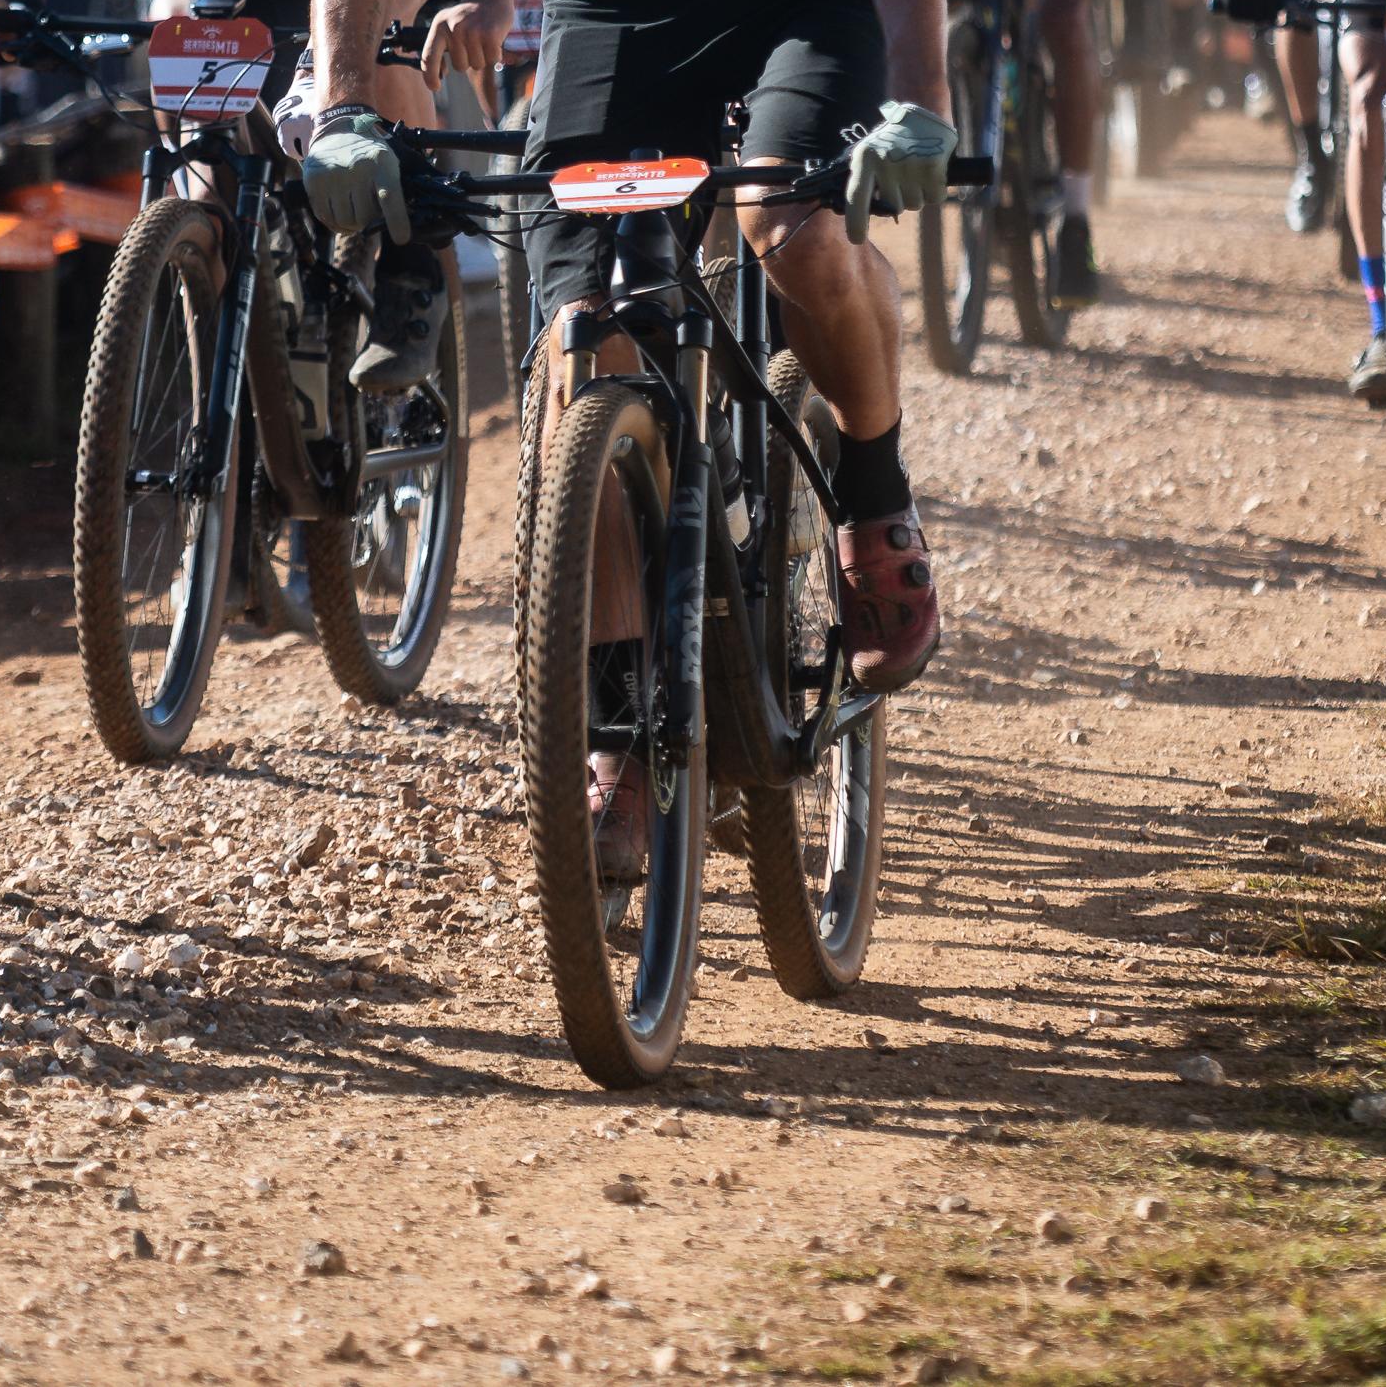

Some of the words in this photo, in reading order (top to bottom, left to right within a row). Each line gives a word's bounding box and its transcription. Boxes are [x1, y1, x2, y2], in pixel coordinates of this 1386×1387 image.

[198, 61, 219, 84] 5
[636, 170, 667, 179] MTB
[615, 182, 638, 194] 6
